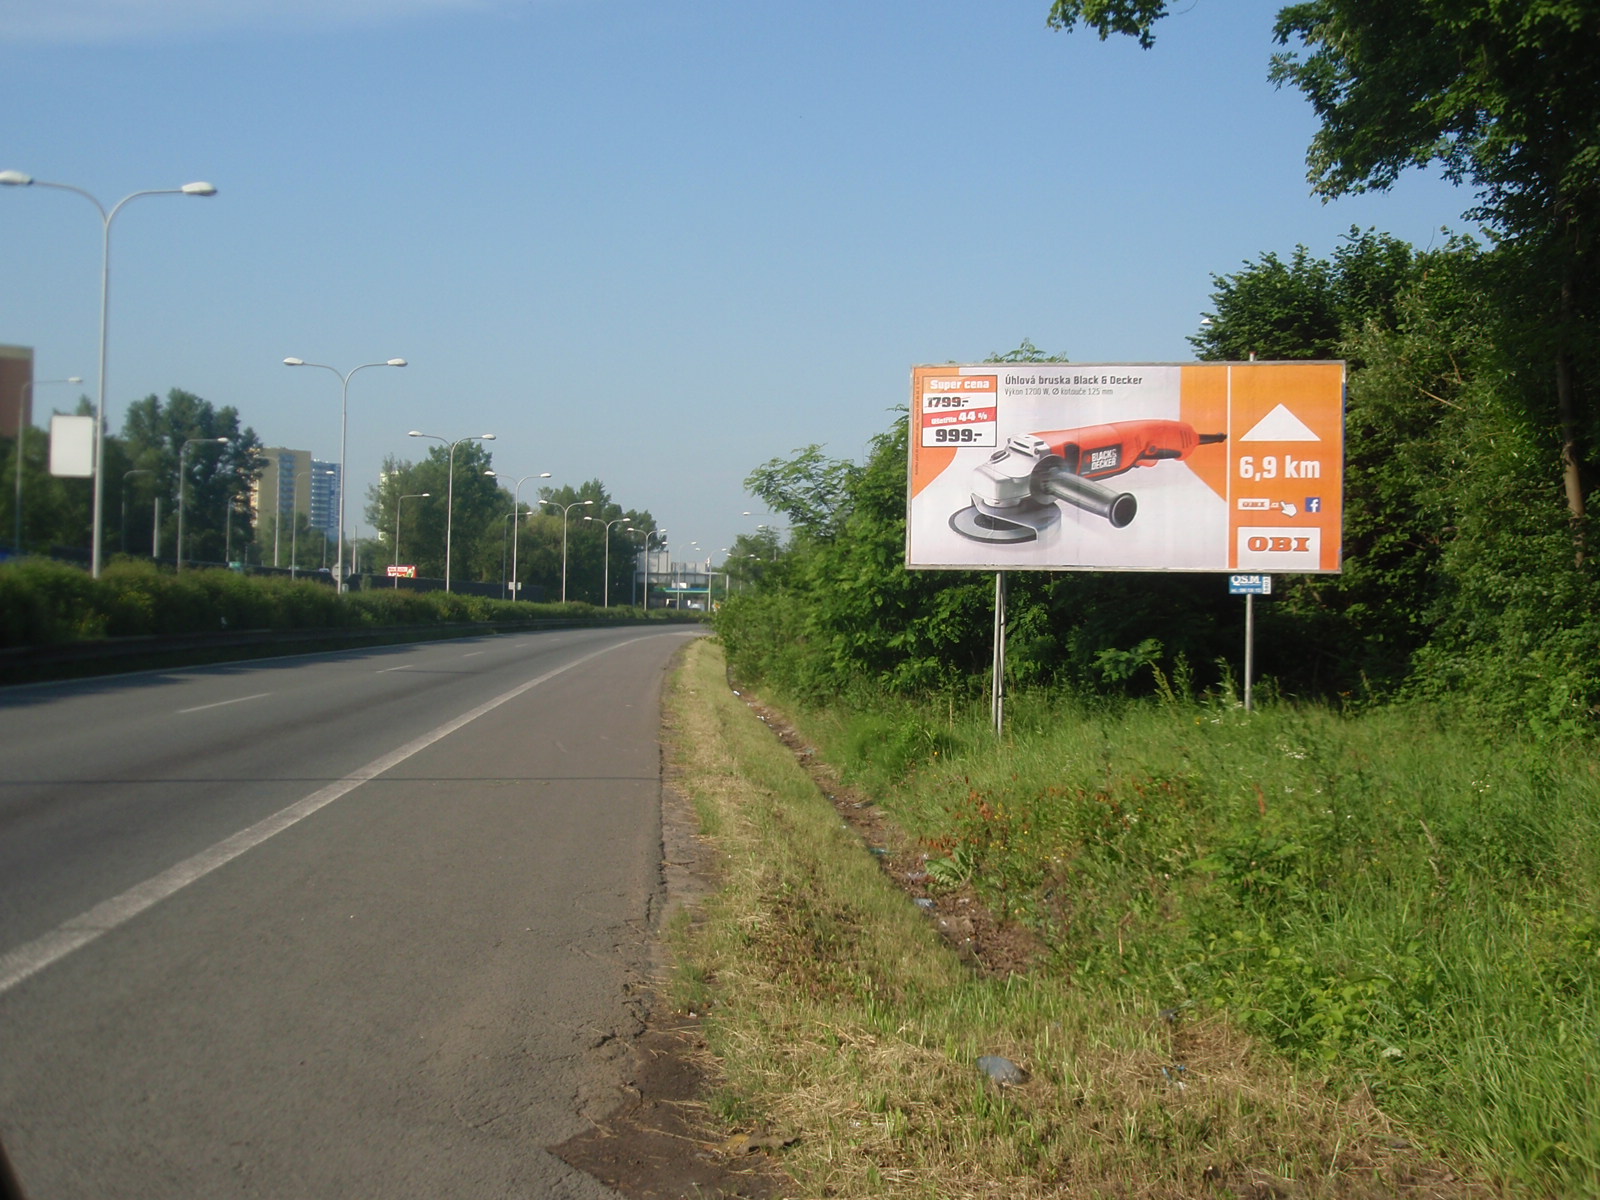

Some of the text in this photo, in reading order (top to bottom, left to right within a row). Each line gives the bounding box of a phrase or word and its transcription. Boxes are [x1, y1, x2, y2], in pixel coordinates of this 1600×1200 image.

[1005, 374, 1143, 385] Úhlová bruska Black & Decker
[930, 380, 989, 391] Super cena
[1004, 387, 1023, 396] Výkon
[1088, 387, 1100, 395] 125
[958, 411, 976, 422] 44
[1091, 457, 1116, 470] DECKER
[1239, 454, 1321, 482] 6,9 km
[1247, 536, 1310, 552] OBI
[1231, 575, 1261, 586] QSM
